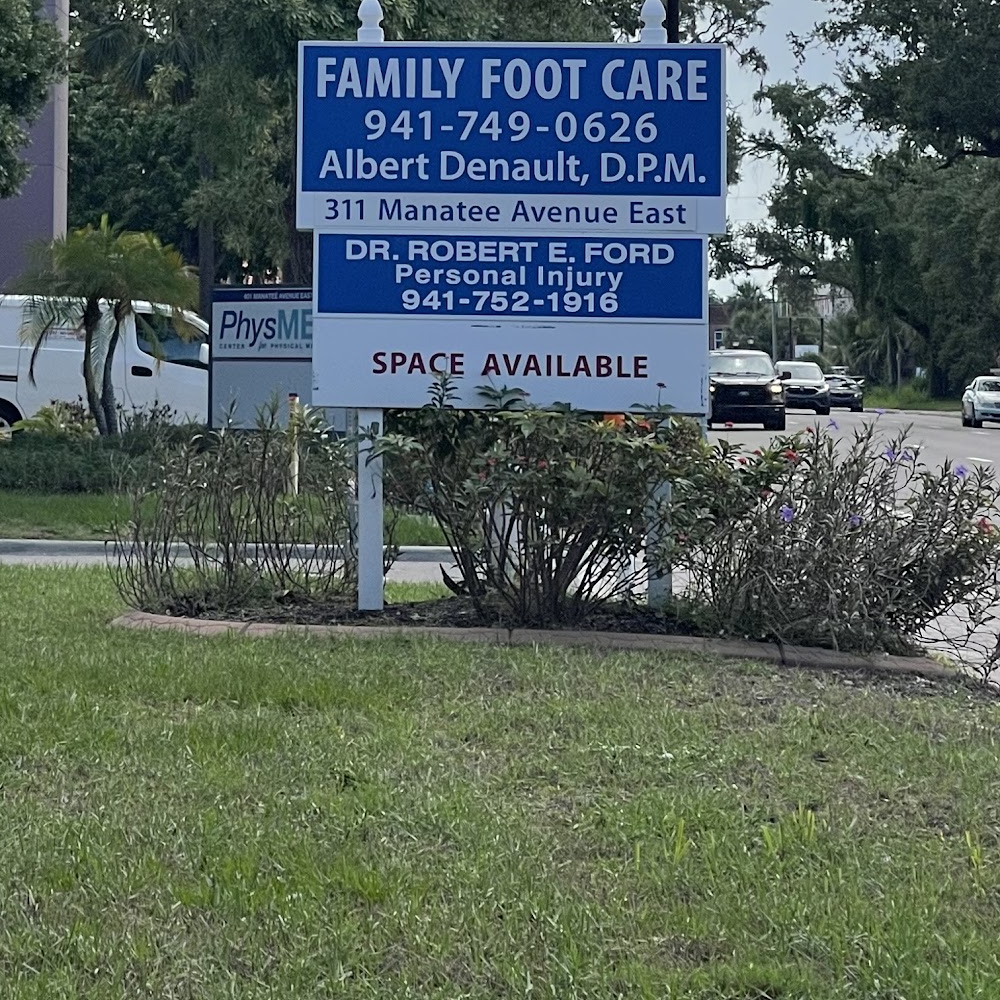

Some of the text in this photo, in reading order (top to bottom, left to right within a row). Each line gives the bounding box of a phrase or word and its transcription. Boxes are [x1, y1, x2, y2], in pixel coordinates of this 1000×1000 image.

[316, 57, 708, 101] FAMILY FOOT CARE
[364, 109, 658, 143] 941-749-0626
[319, 148, 707, 187] Albert Denault, D.P.M.
[325, 198, 687, 225] 311 Manatee Avenue East
[345, 239, 676, 265] DR. ROBERT E. FORD
[395, 263, 624, 292] Personal Injury
[401, 290, 620, 313] 941-752-1916
[372, 352, 648, 379] SPACE AVAILABLE
